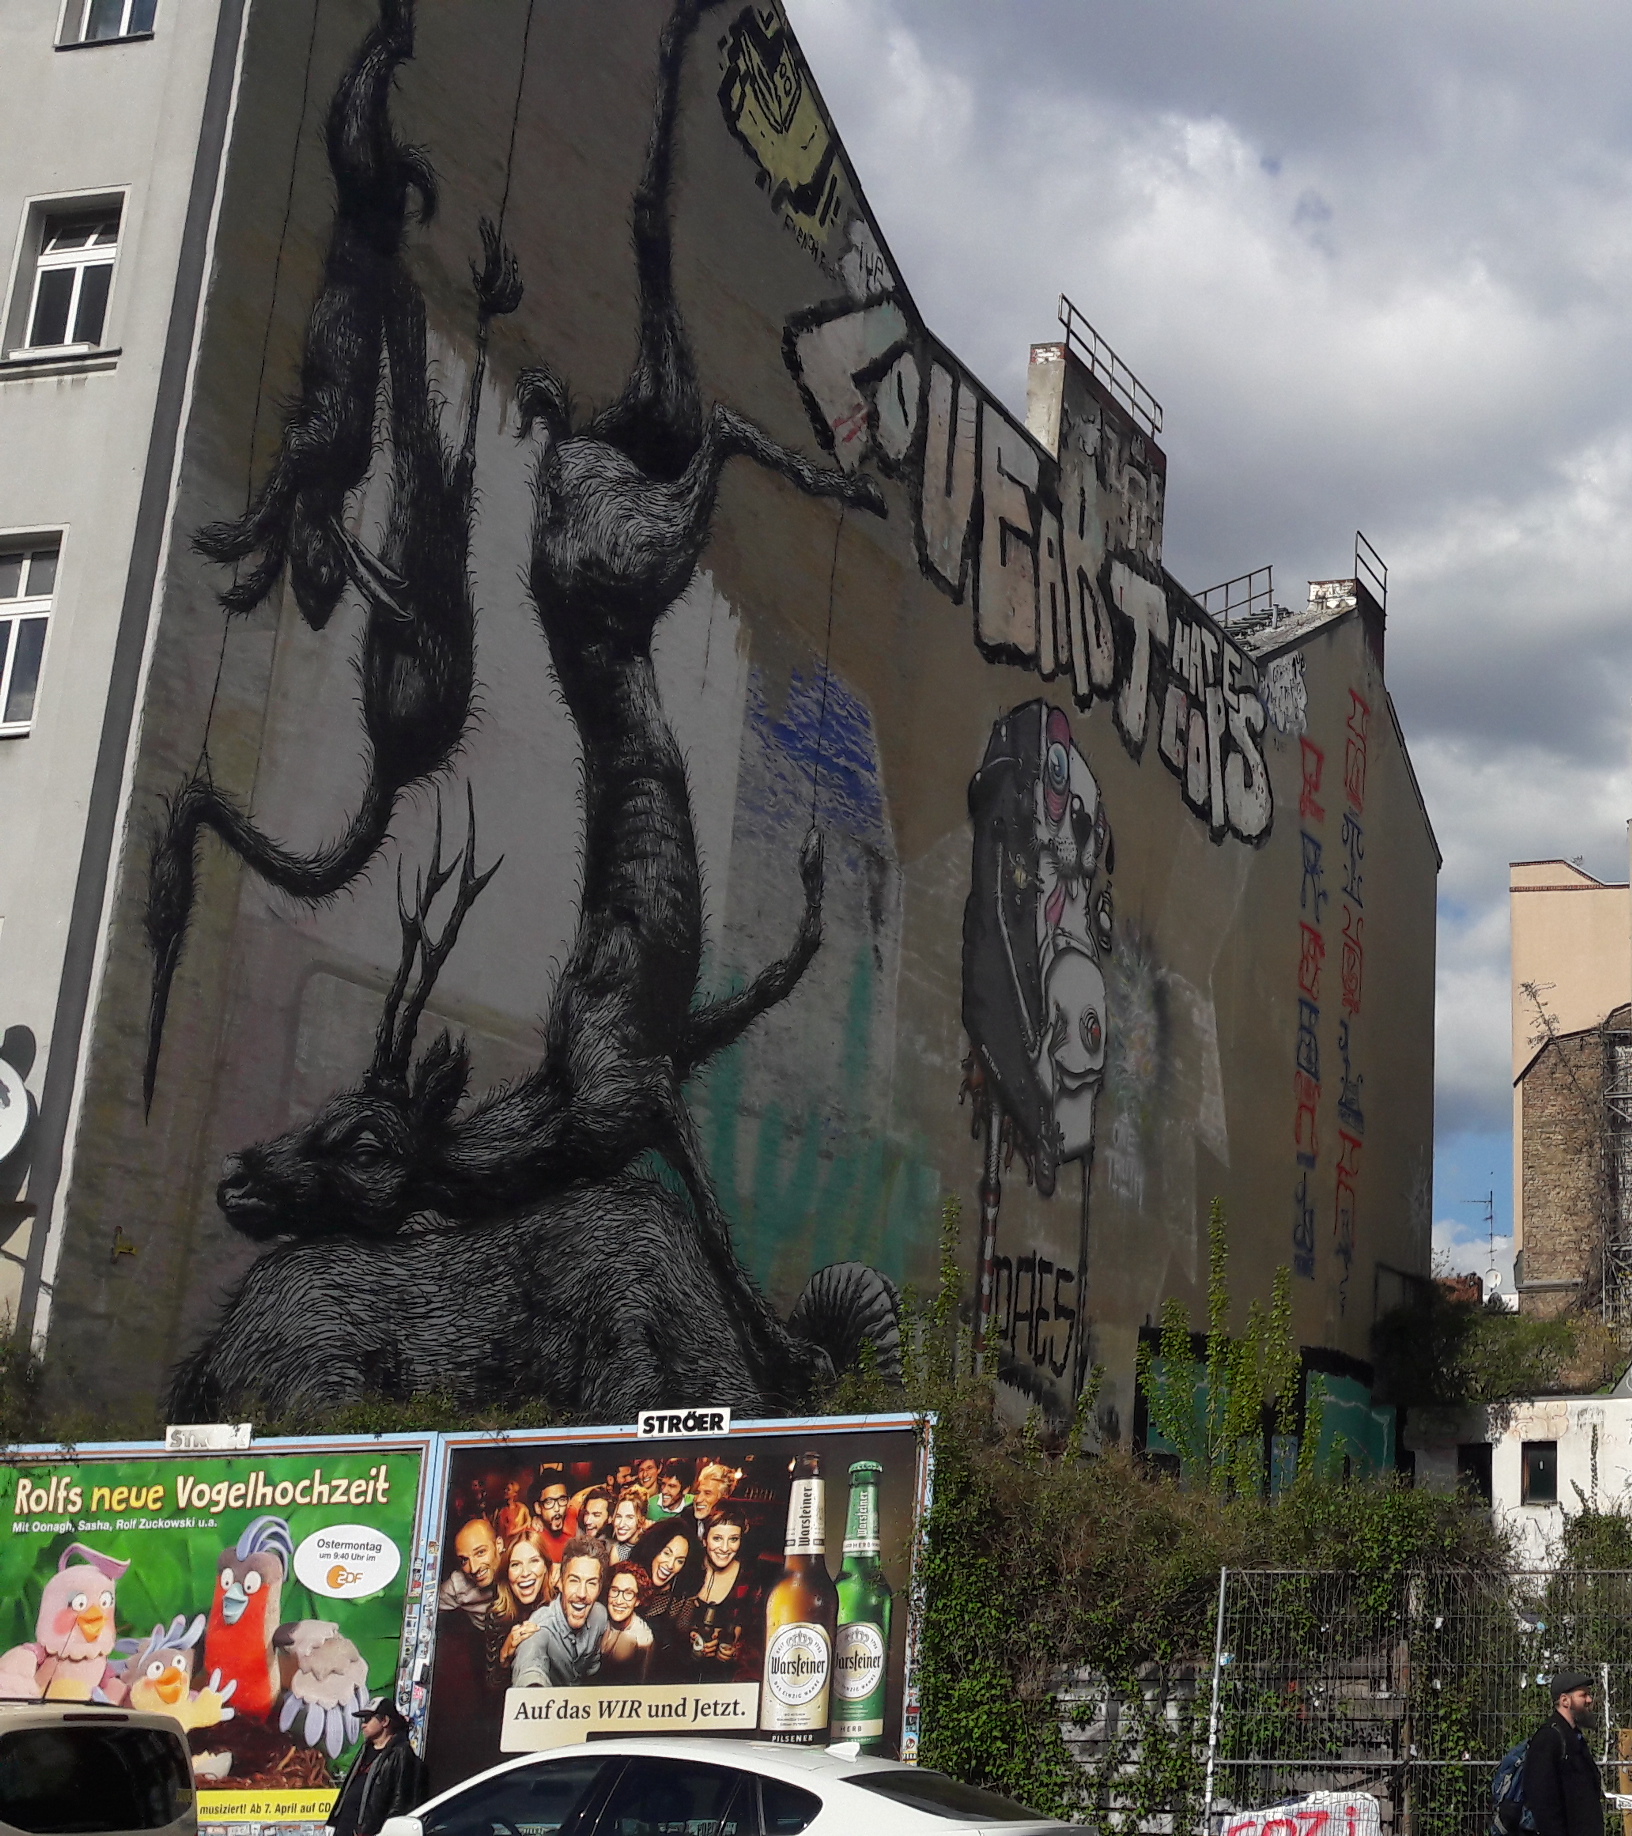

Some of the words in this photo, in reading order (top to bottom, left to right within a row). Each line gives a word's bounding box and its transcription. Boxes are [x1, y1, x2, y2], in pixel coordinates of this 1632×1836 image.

[1171, 615, 1242, 714] HATE
[1158, 682, 1273, 846] COPS
[642, 1410, 725, 1435] STRÖER
[14, 1475, 84, 1515] Rolfs
[90, 1483, 165, 1513] neue
[176, 1463, 390, 1514] Vogelhochzeit
[12, 1521, 29, 1533] Mit
[31, 1520, 75, 1534] Oonagh,
[77, 1519, 113, 1532] Sasha,
[116, 1518, 137, 1530] Rolf
[138, 1516, 196, 1529] Zuckowski
[197, 1518, 218, 1528] u.a.
[797, 1486, 813, 1547] Warsteiner
[855, 1491, 868, 1538] Warsteiner
[317, 1538, 382, 1553] Ostermontag
[333, 1552, 349, 1560] 9:40
[350, 1552, 365, 1561] Uhr
[366, 1553, 376, 1562] im
[771, 1653, 826, 1677] Warsteiner
[513, 1698, 556, 1721] Auf
[556, 1699, 591, 1720] das
[598, 1699, 642, 1720] WIR
[646, 1696, 688, 1718] und
[690, 1697, 746, 1722] Jetzt.
[771, 1734, 813, 1743] PILSENER
[200, 1803, 246, 1815] musiziert!
[249, 1803, 262, 1814] Ab
[264, 1803, 271, 1814] 7.
[274, 1802, 297, 1816] April
[300, 1802, 316, 1814] auf
[318, 1802, 332, 1813] CD
